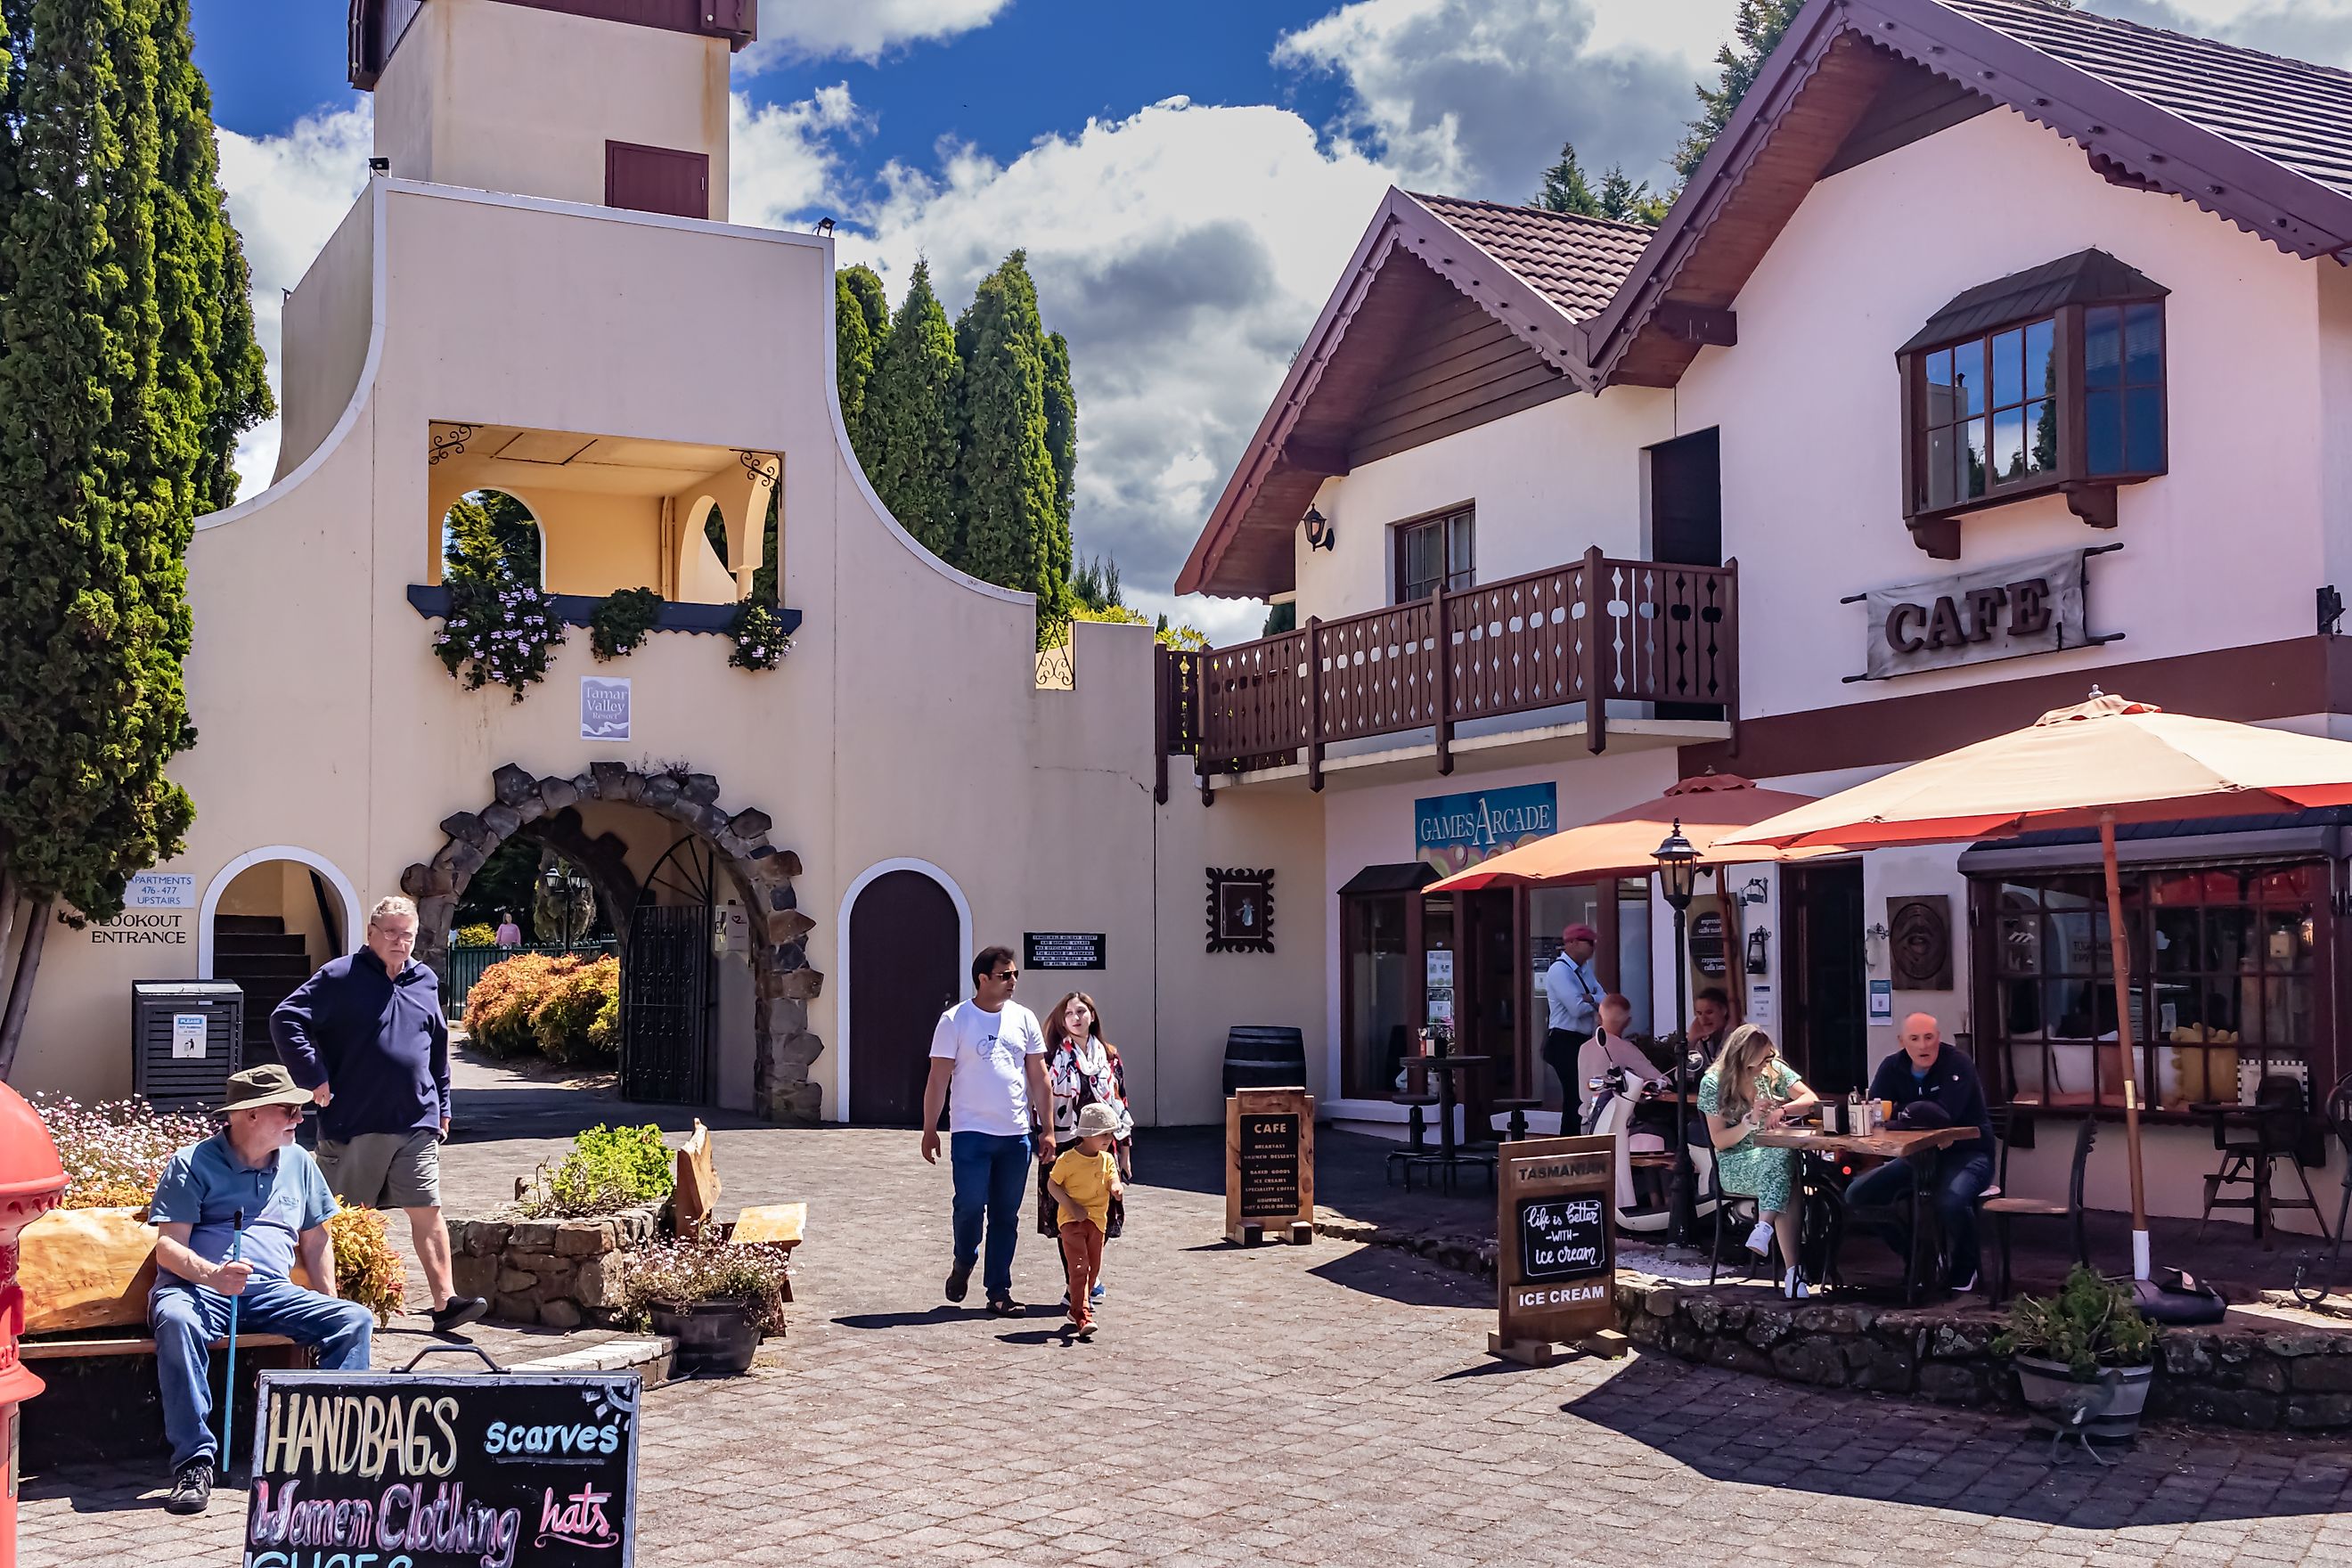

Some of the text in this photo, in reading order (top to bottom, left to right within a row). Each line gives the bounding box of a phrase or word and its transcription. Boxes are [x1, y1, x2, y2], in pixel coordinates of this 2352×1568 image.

[1885, 578, 2052, 653] CAFE
[587, 687, 628, 699] Tamar
[587, 699, 625, 715] Valley
[1421, 797, 1550, 845] GAMES ARCADE
[137, 896, 181, 905] UPSTAIRS
[92, 931, 186, 943] ENTRANCE
[1254, 1123, 1286, 1133] CAFE
[1519, 1161, 1606, 1180] TASMANIAN
[1528, 1203, 1600, 1231] life is better
[1536, 1246, 1597, 1265] ice cream
[1519, 1286, 1605, 1307] ICE CREAM
[265, 1392, 460, 1481] HANDBAGS
[538, 1482, 613, 1539] hats
[249, 1479, 522, 1568] Women Clothing
